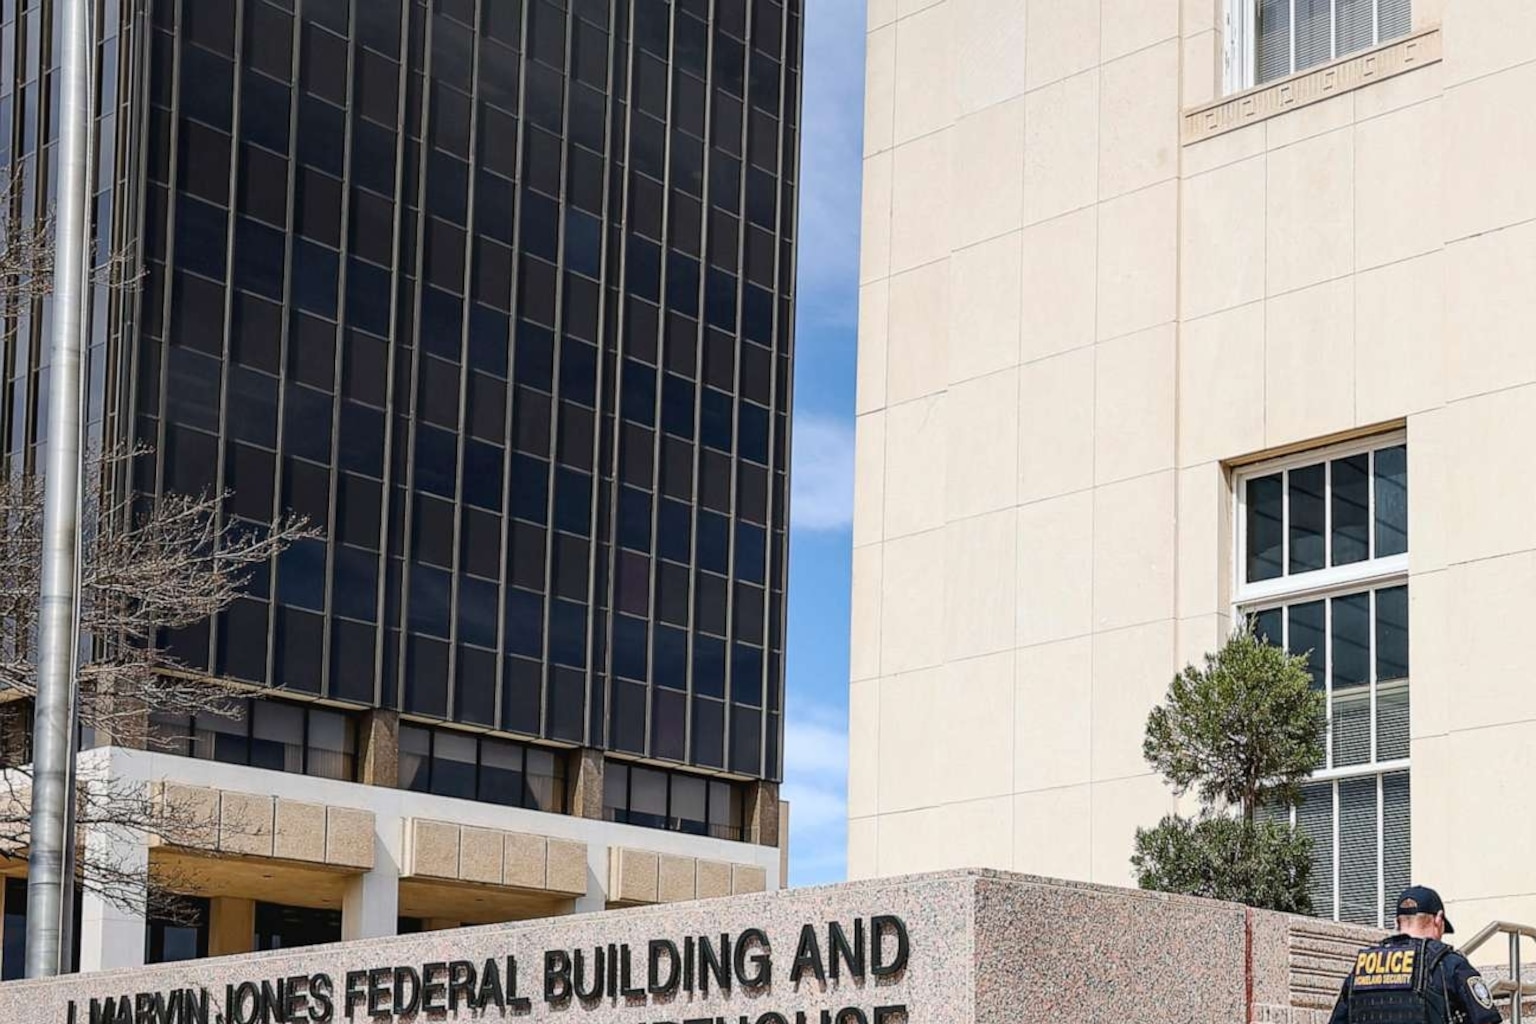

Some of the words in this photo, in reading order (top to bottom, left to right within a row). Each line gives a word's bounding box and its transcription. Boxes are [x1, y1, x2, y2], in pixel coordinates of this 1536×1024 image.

[345, 955, 529, 1019] FEDERAL
[545, 928, 772, 1001] BUILDING
[790, 915, 909, 981] AND
[1355, 951, 1415, 975] POLICE
